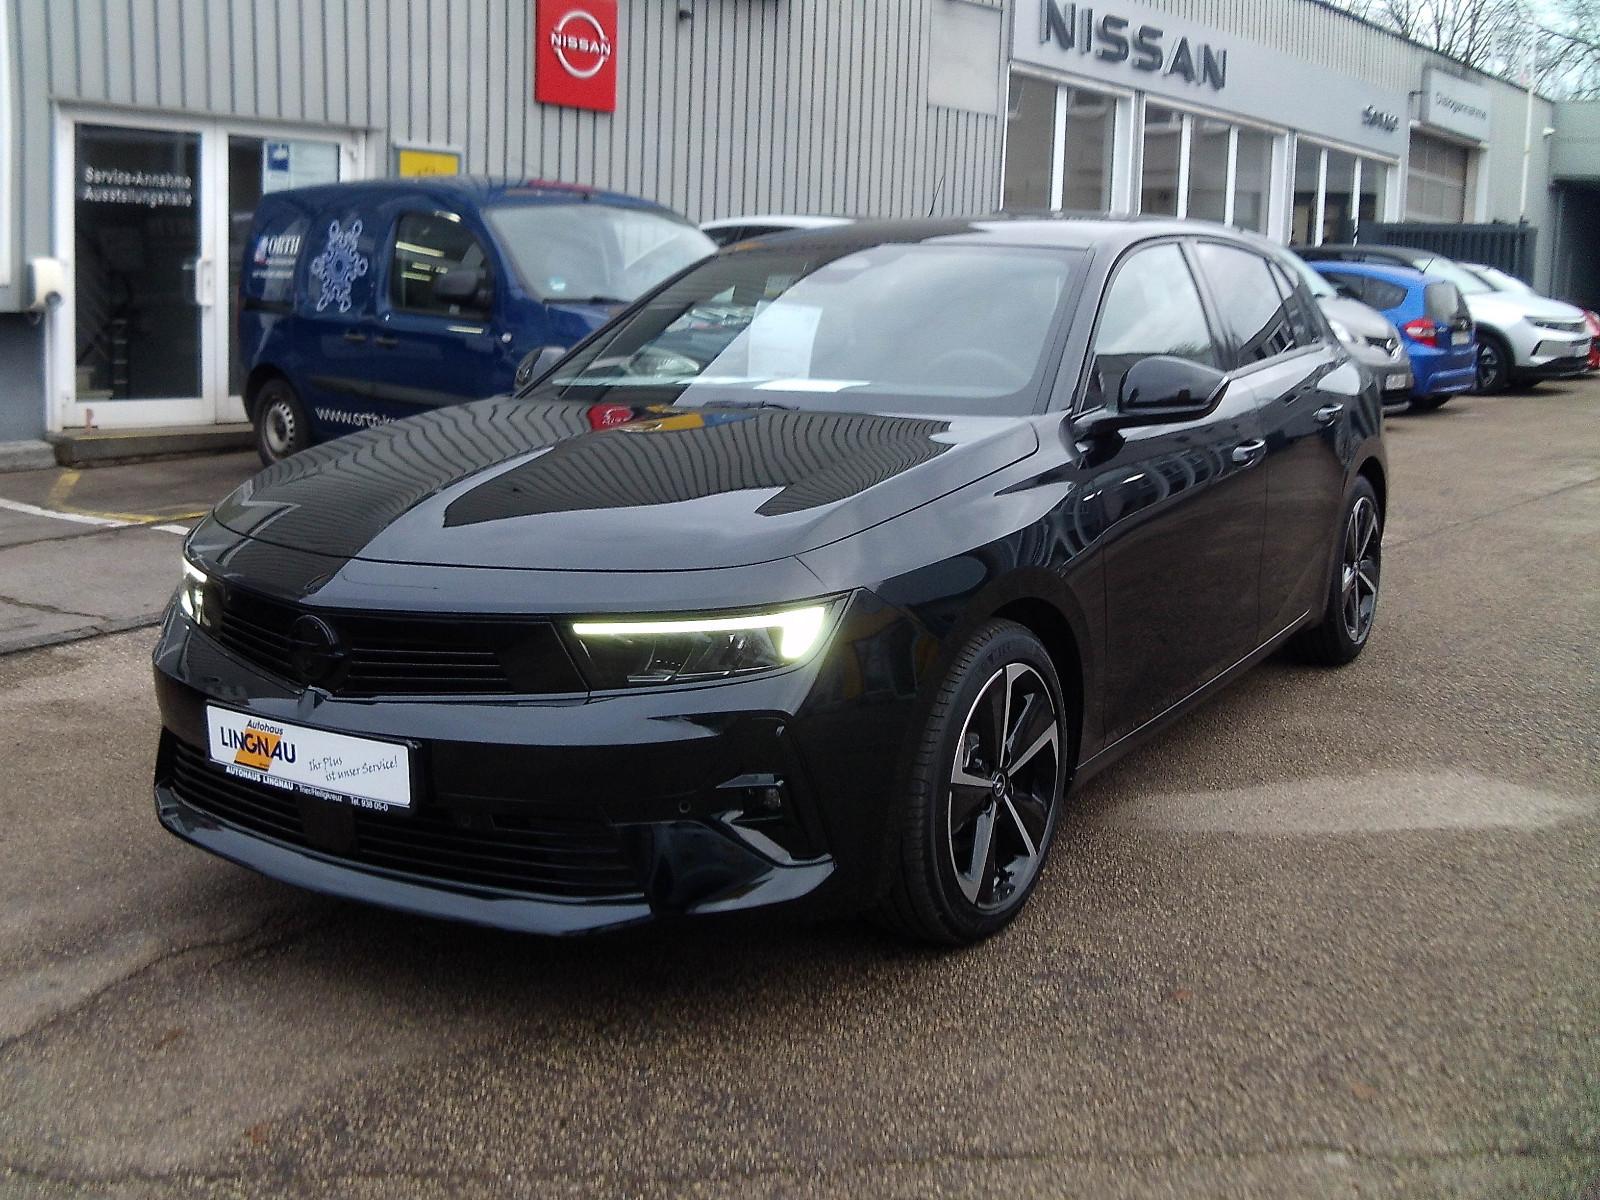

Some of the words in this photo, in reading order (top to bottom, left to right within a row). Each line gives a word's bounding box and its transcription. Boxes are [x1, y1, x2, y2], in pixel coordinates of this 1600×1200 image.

[551, 32, 611, 57] NISSAN
[1039, 0, 1228, 91] NISSAN
[84, 166, 193, 189] Service-Annahme
[267, 234, 301, 255] ORTH
[247, 719, 284, 736] Autohaus
[220, 726, 297, 764] LINGNAU
[309, 759, 321, 772] Ihr
[323, 756, 343, 770] Plus
[326, 771, 336, 781] ist
[338, 767, 360, 780] unser
[362, 755, 398, 774] Service!
[226, 765, 261, 782] AUTOHAUS
[263, 774, 294, 791] LINGNAU
